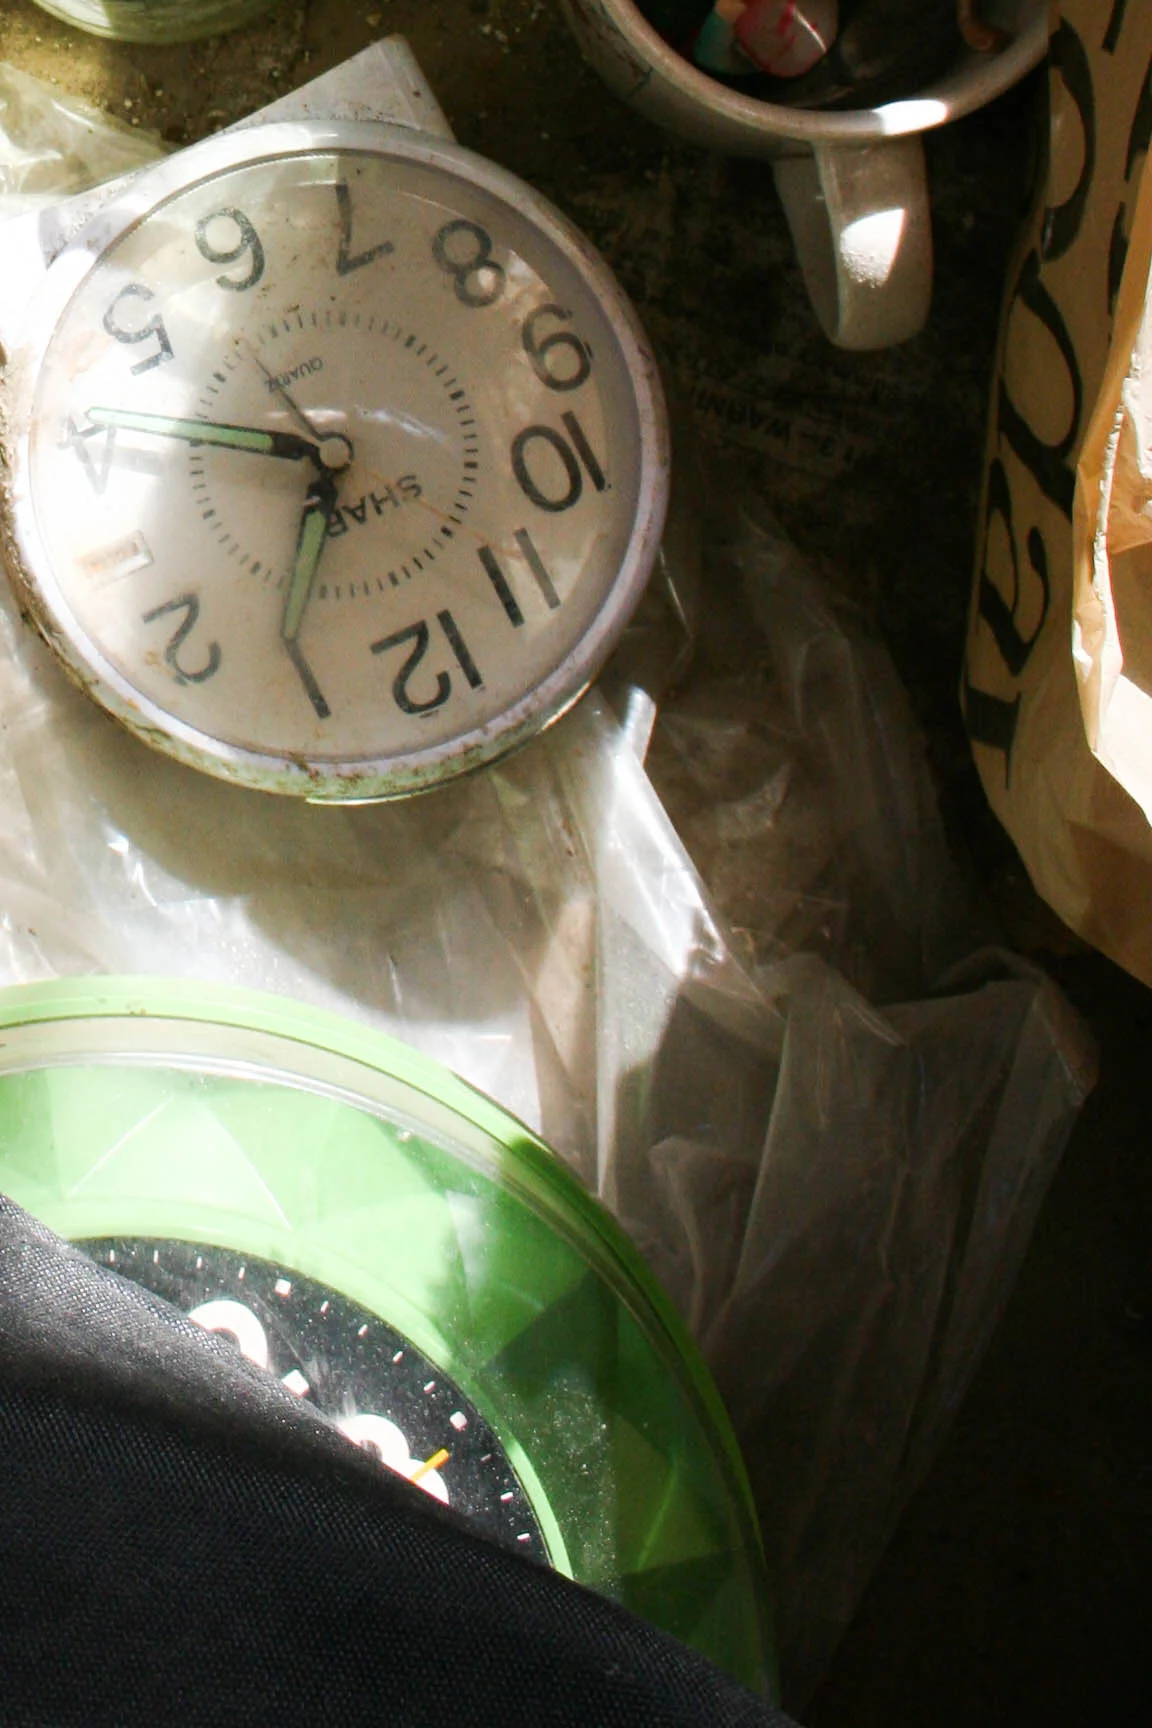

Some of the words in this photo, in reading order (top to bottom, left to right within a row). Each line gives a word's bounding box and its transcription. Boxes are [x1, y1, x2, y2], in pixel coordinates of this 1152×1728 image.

[195, 208, 265, 291] 6
[335, 183, 393, 277] 7
[432, 219, 504, 307] 8
[101, 284, 173, 375] 5
[521, 303, 591, 391] 9
[320, 474, 422, 538] SHAR
[511, 412, 607, 514] 10
[478, 528, 561, 628] 11
[143, 593, 222, 685] 2
[371, 609, 484, 715] 12
